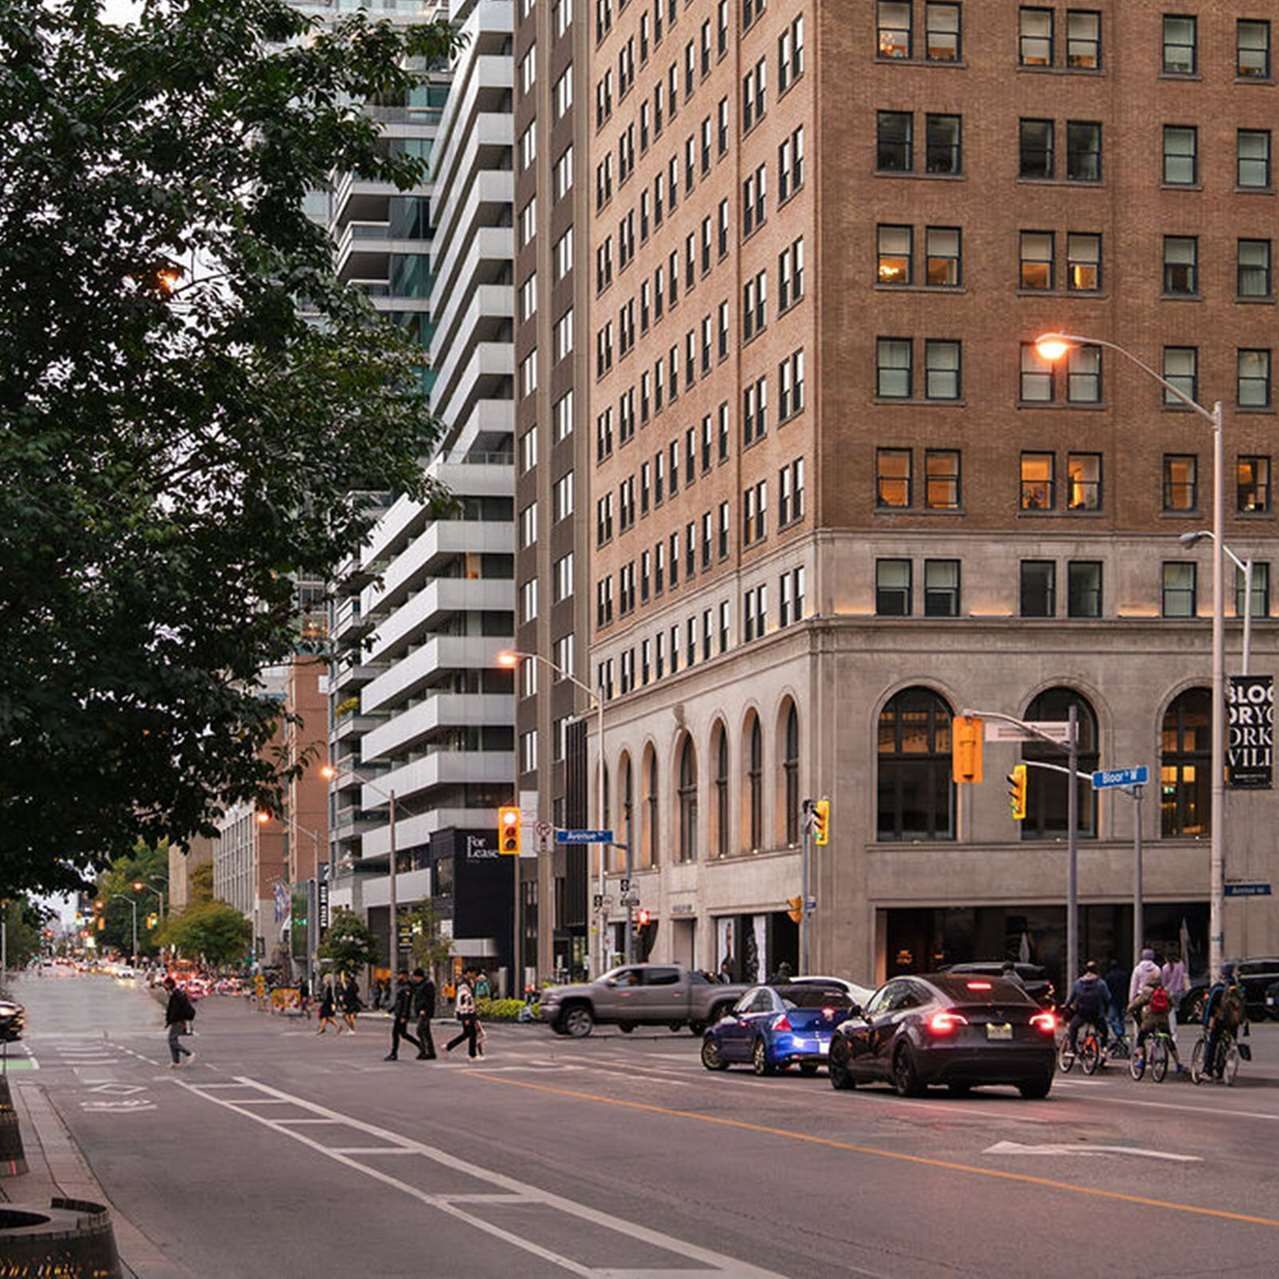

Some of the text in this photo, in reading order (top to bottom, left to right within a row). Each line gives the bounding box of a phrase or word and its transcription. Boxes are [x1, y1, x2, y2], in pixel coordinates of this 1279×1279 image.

[1102, 771, 1123, 784] Bloor
[467, 835, 486, 847] For
[566, 831, 597, 840] Avenue
[467, 847, 499, 858] Lease
